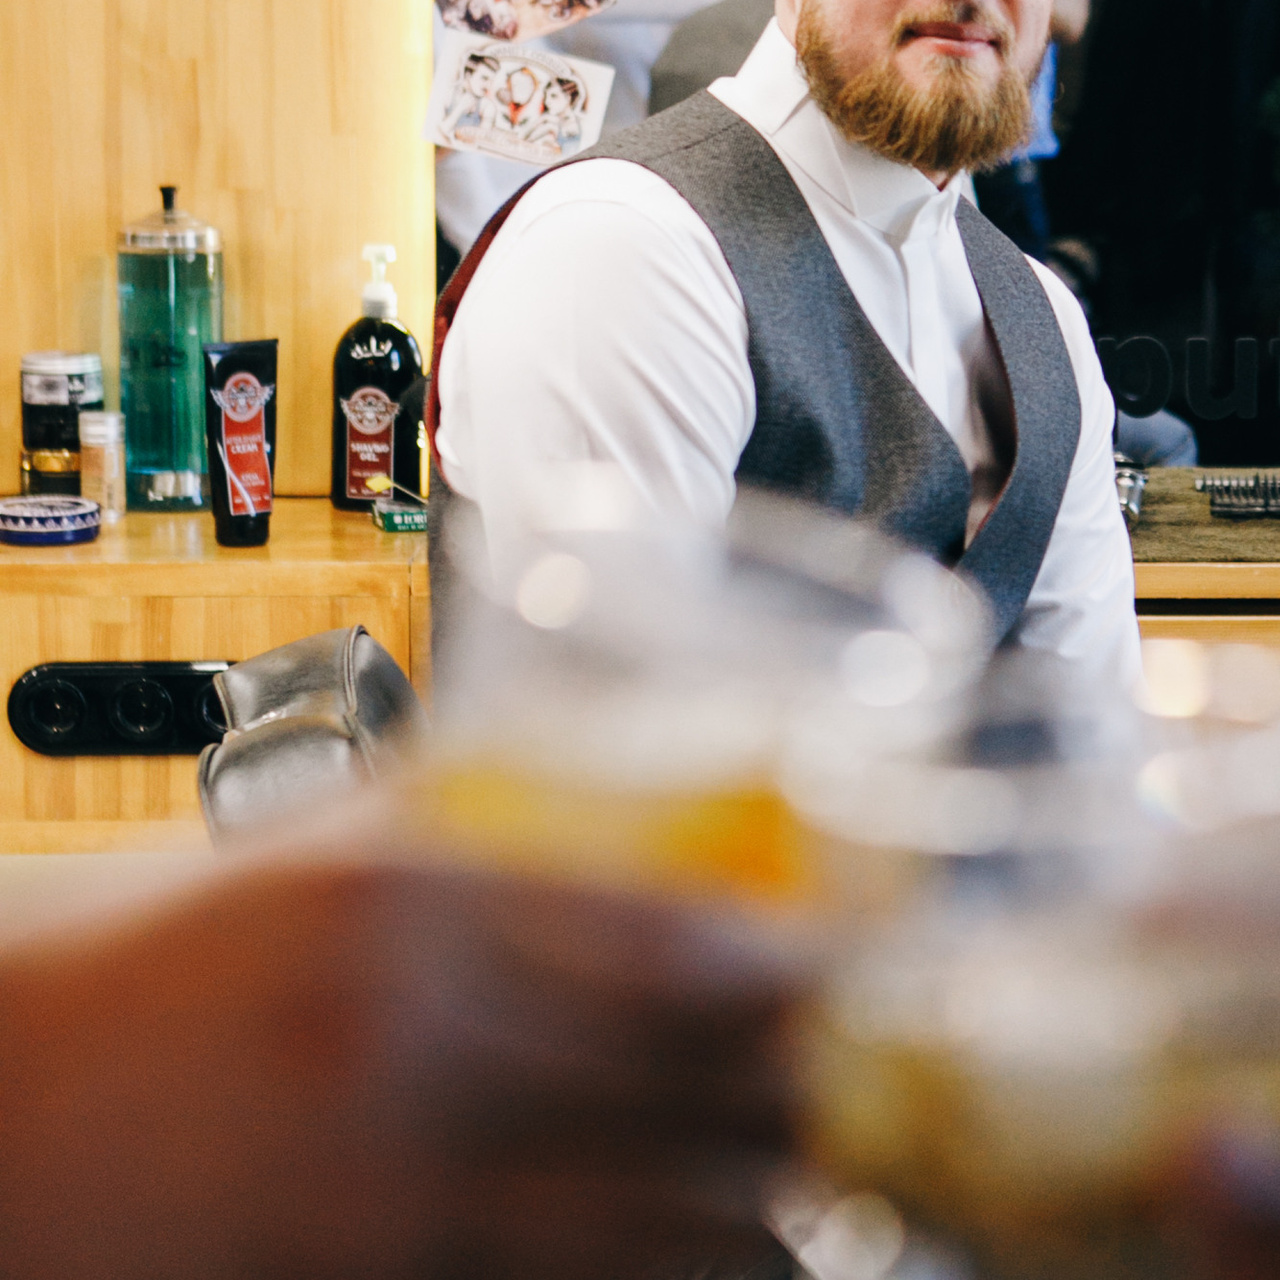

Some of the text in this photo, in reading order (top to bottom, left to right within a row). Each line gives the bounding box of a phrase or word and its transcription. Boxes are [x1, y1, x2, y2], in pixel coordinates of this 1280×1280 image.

[231, 442, 259, 454] CREAM
[350, 442, 390, 454] SHAVING
[359, 452, 380, 463] GEL
